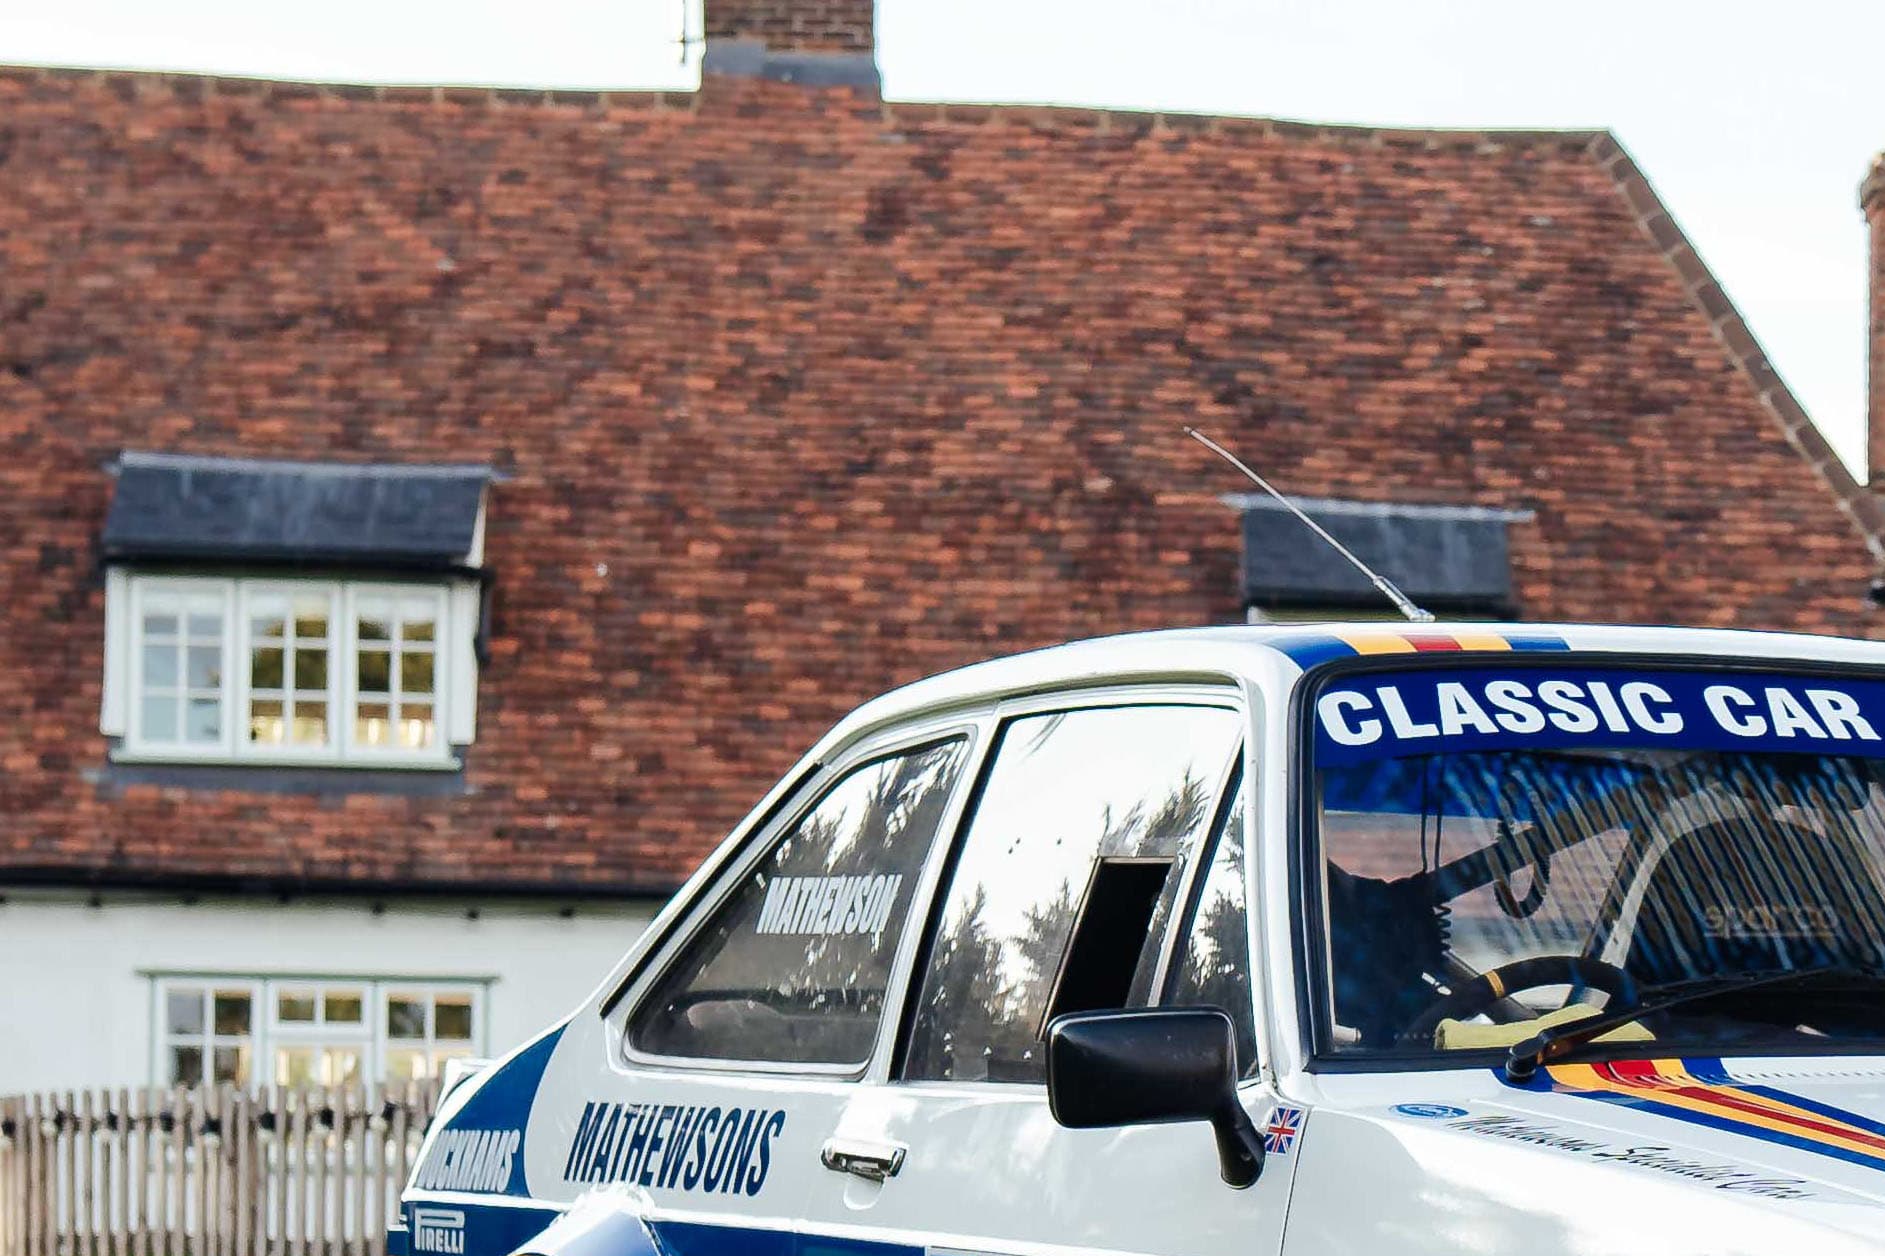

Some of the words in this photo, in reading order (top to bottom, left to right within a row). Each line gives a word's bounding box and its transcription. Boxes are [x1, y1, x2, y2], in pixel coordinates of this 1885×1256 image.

[1316, 679, 1686, 746] CLASSIC
[1703, 683, 1883, 742] CAR
[756, 874, 903, 935] MATHEWSON
[563, 1101, 787, 1197] MATHEWSONS
[414, 1207, 466, 1254] PIRELLI
